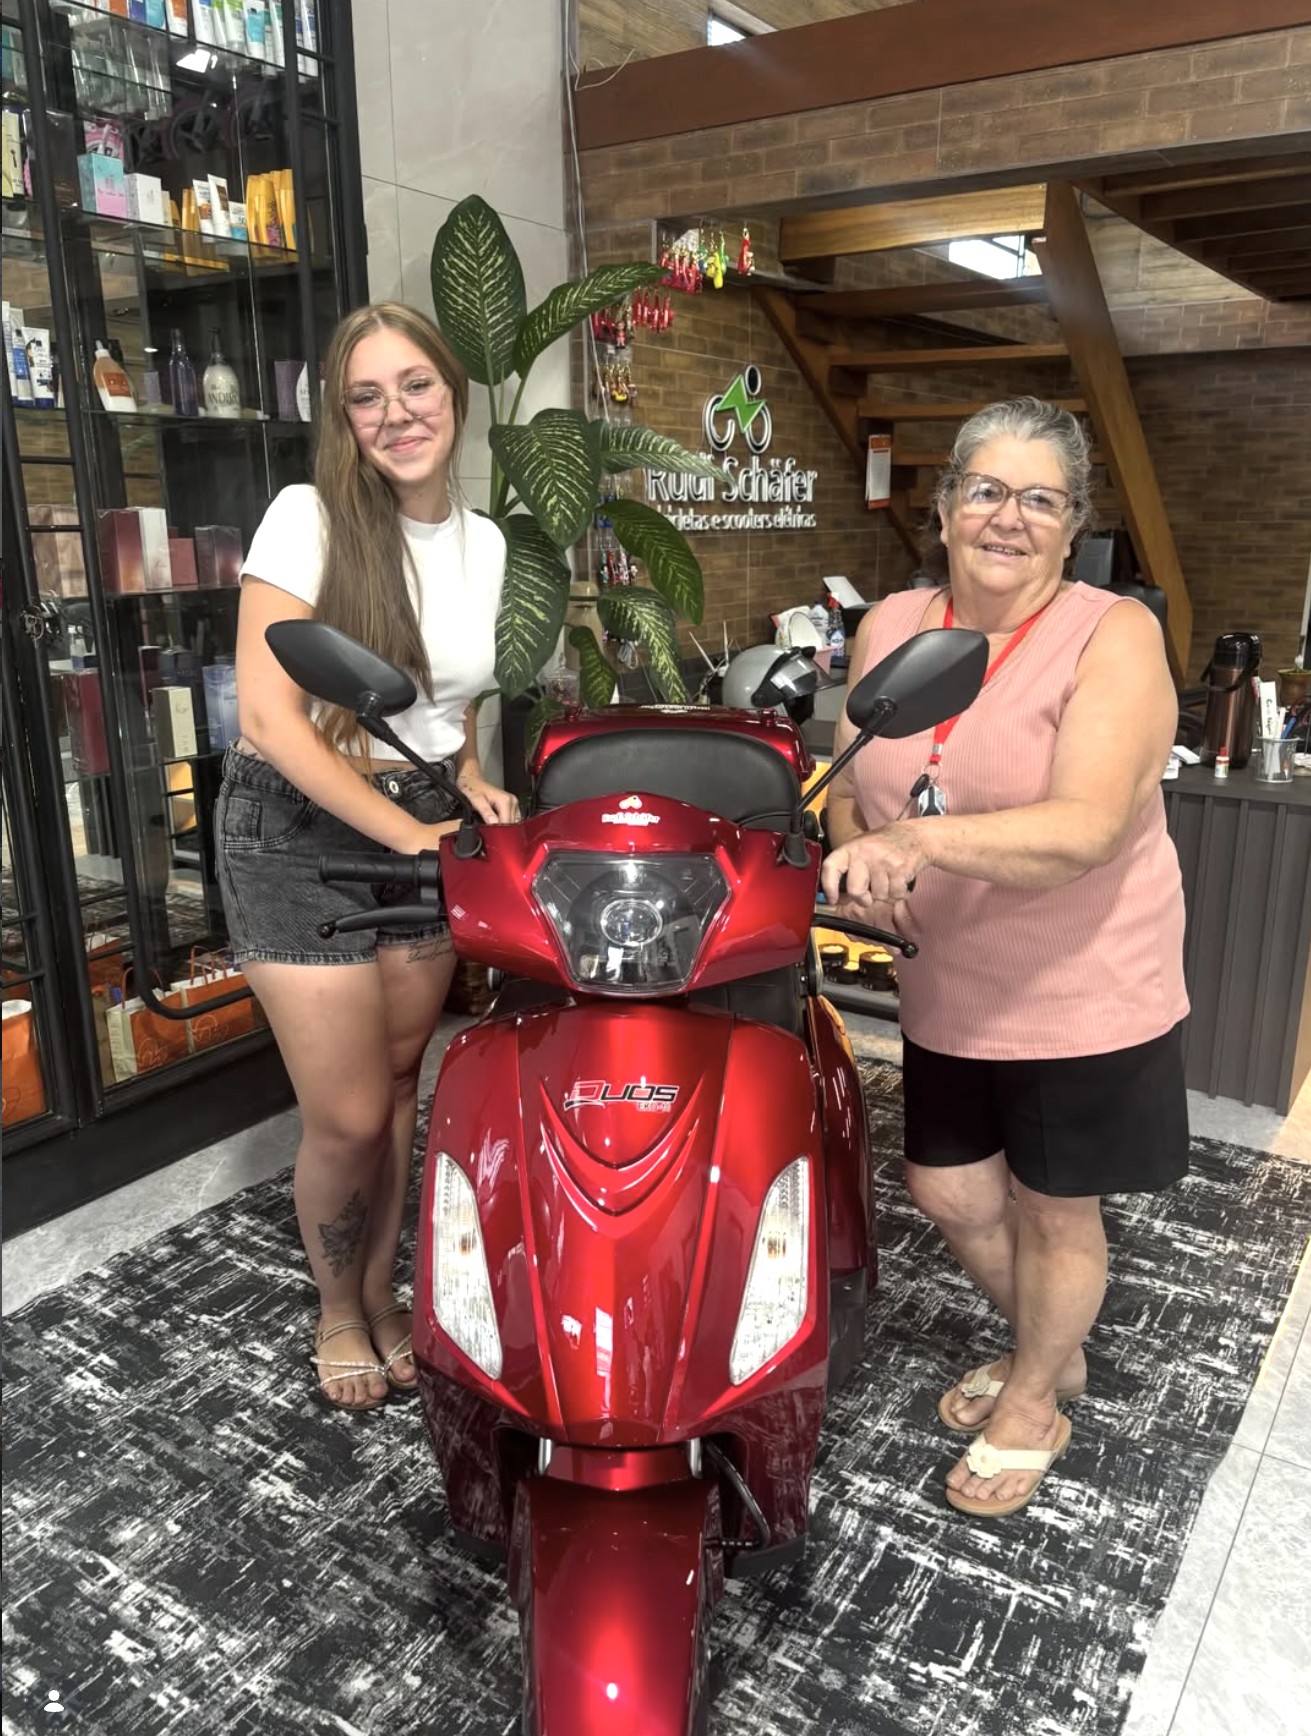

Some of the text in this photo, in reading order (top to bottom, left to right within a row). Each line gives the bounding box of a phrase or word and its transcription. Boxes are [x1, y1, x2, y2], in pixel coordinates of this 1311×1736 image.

[722, 455, 817, 502] Schäfer
[711, 514, 721, 530] e
[722, 507, 773, 530] scooters
